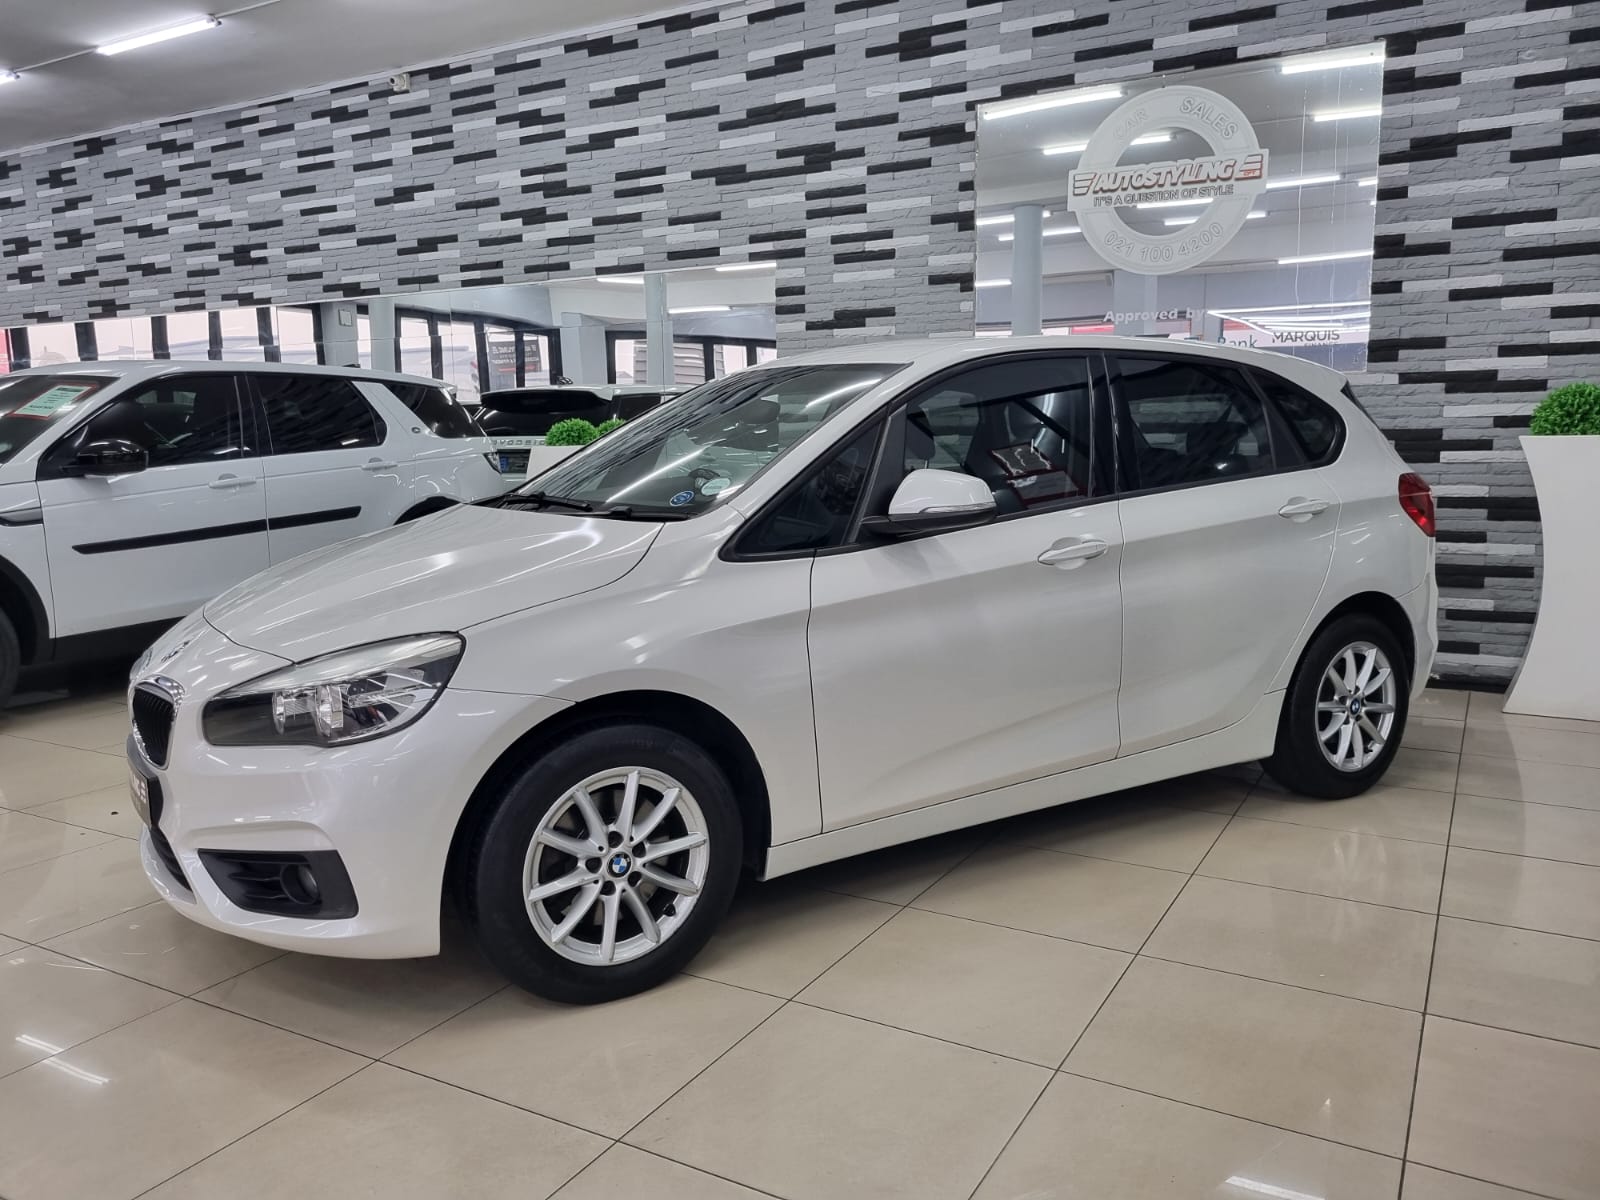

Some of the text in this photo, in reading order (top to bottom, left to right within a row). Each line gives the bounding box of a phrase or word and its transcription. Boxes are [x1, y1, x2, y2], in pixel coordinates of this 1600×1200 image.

[1113, 97, 1238, 139] CAR SALES
[1092, 160, 1237, 193] AUTOSTYLING
[1093, 184, 1234, 207] IT'S A QUESTION OF STYLE
[1104, 223, 1224, 262] 021 100 4200
[1103, 308, 1178, 325] Approved
[1272, 330, 1340, 344] MARQUIS
